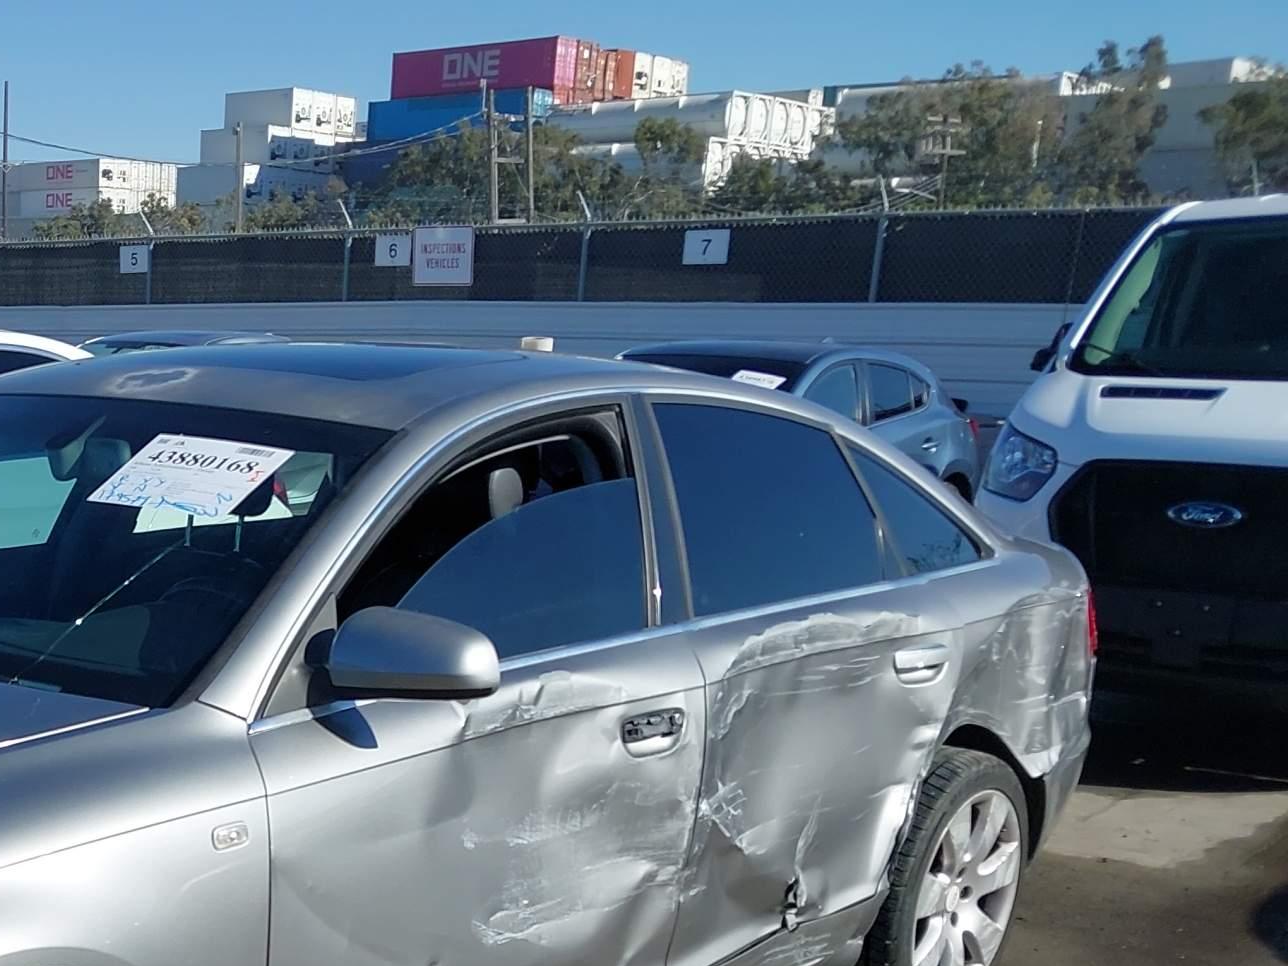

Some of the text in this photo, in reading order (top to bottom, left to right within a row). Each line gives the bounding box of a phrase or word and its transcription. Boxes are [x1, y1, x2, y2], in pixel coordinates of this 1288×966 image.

[442, 50, 501, 81] ONE
[46, 165, 74, 180] ONE
[45, 193, 73, 208] ONE
[388, 243, 398, 259] 6
[701, 239, 713, 256] 7
[130, 252, 138, 266] 5
[425, 258, 460, 269] VEHICLES
[148, 449, 260, 474] 43880168
[1181, 505, 1225, 521] Ford
